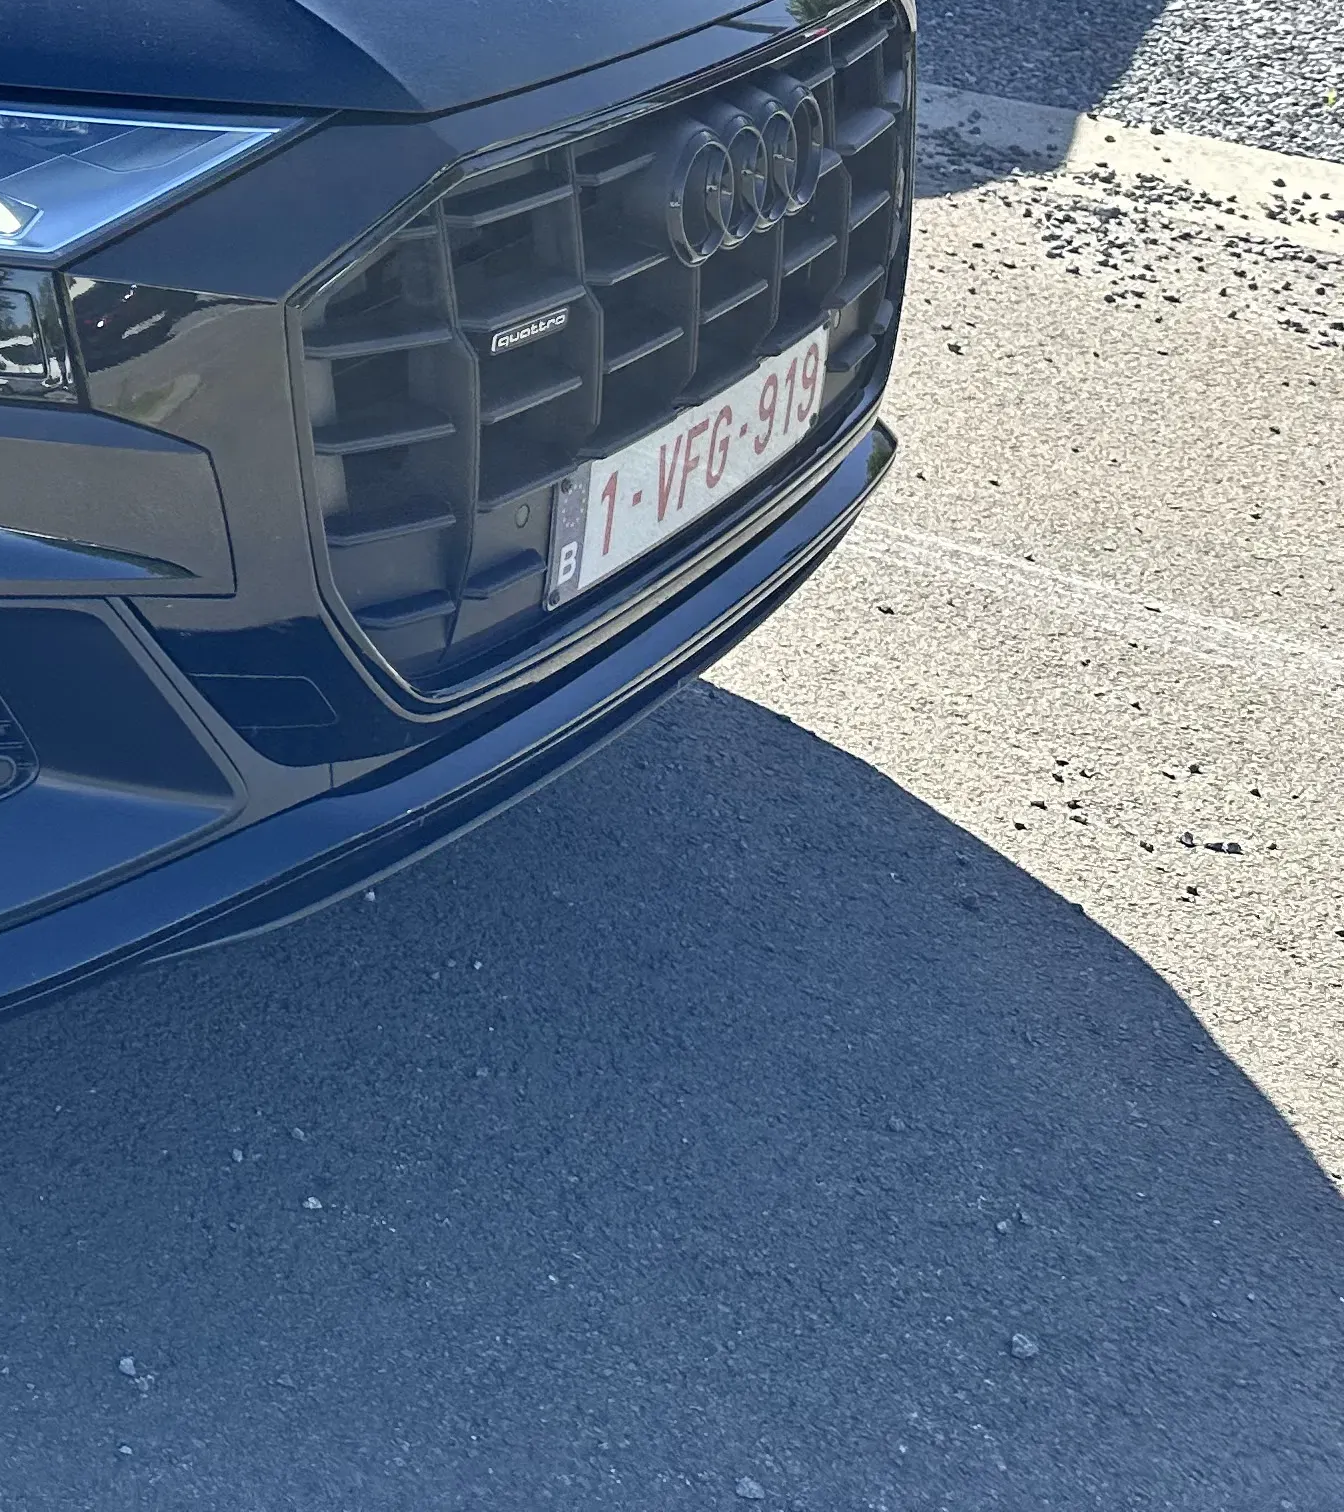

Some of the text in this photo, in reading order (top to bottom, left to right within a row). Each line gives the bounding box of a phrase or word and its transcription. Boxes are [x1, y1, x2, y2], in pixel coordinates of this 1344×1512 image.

[497, 314, 566, 348] quattro
[601, 342, 819, 557] 1-VFG-919
[557, 540, 579, 586] B
